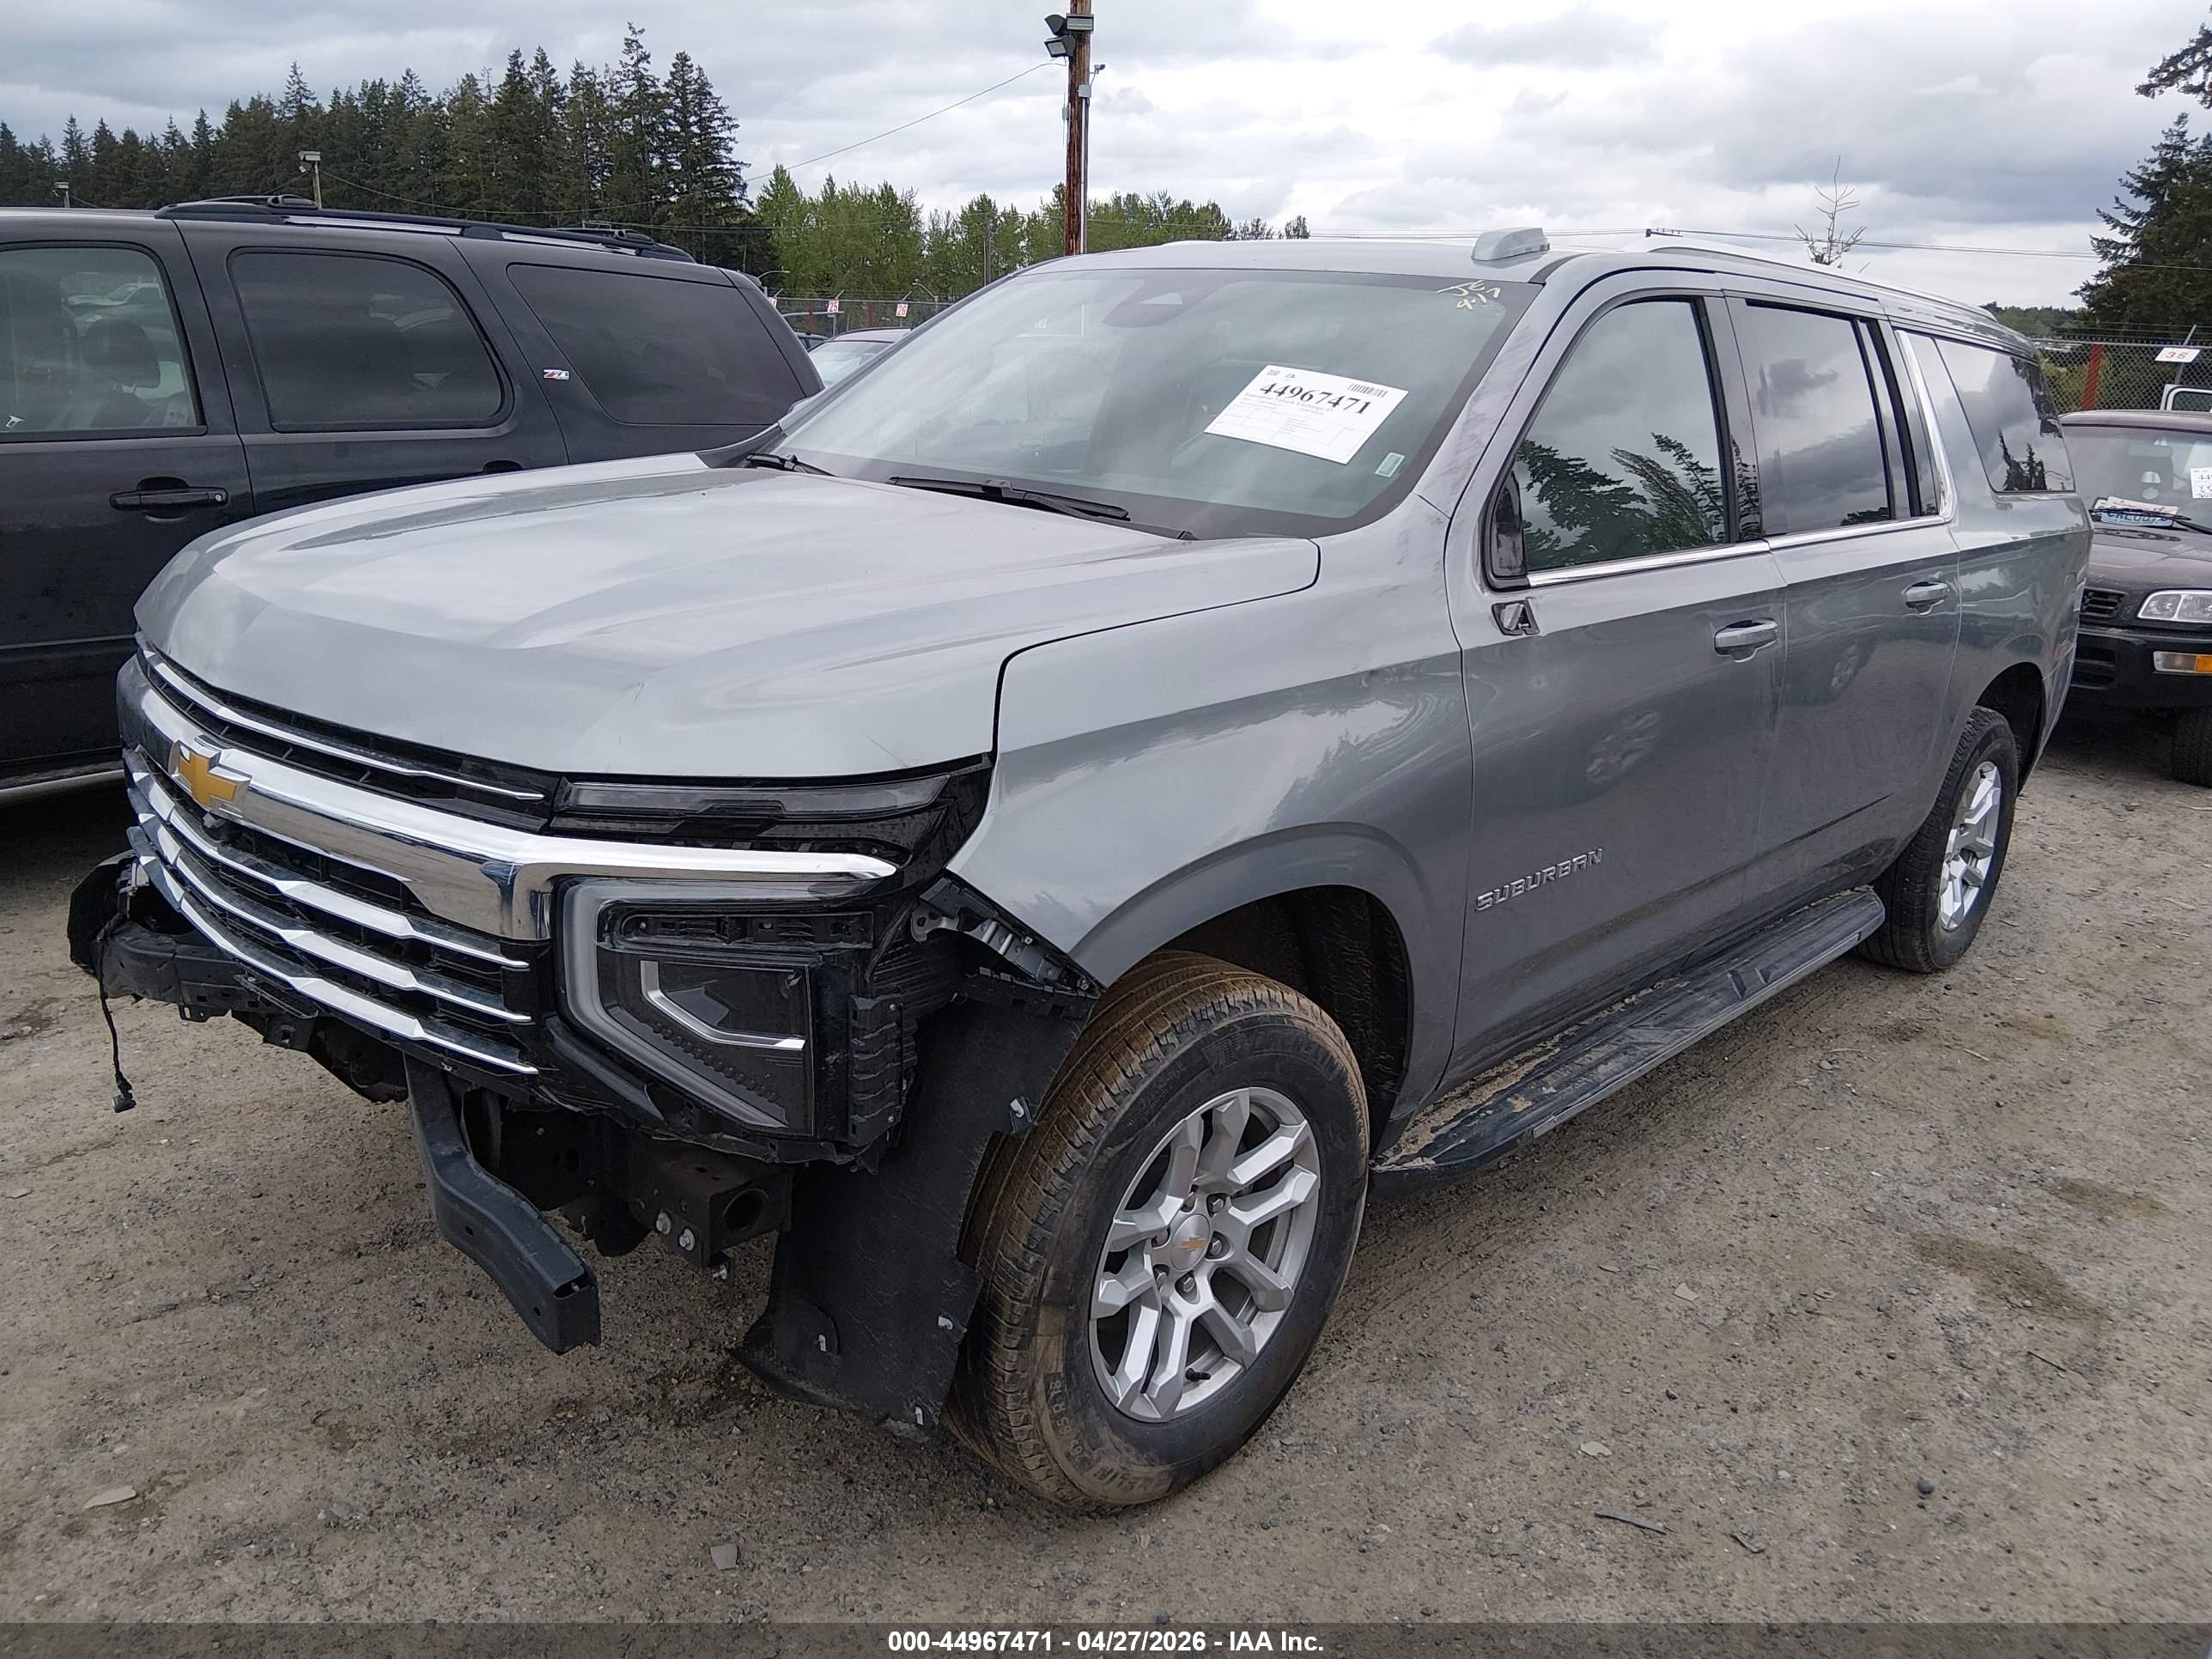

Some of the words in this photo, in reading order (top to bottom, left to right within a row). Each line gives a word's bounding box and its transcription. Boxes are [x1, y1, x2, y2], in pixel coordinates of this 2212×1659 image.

[829, 301, 838, 313] 25
[897, 304, 907, 316] 26
[1260, 382, 1372, 415] 44967471
[1476, 848, 1604, 912] SUBURBAN
